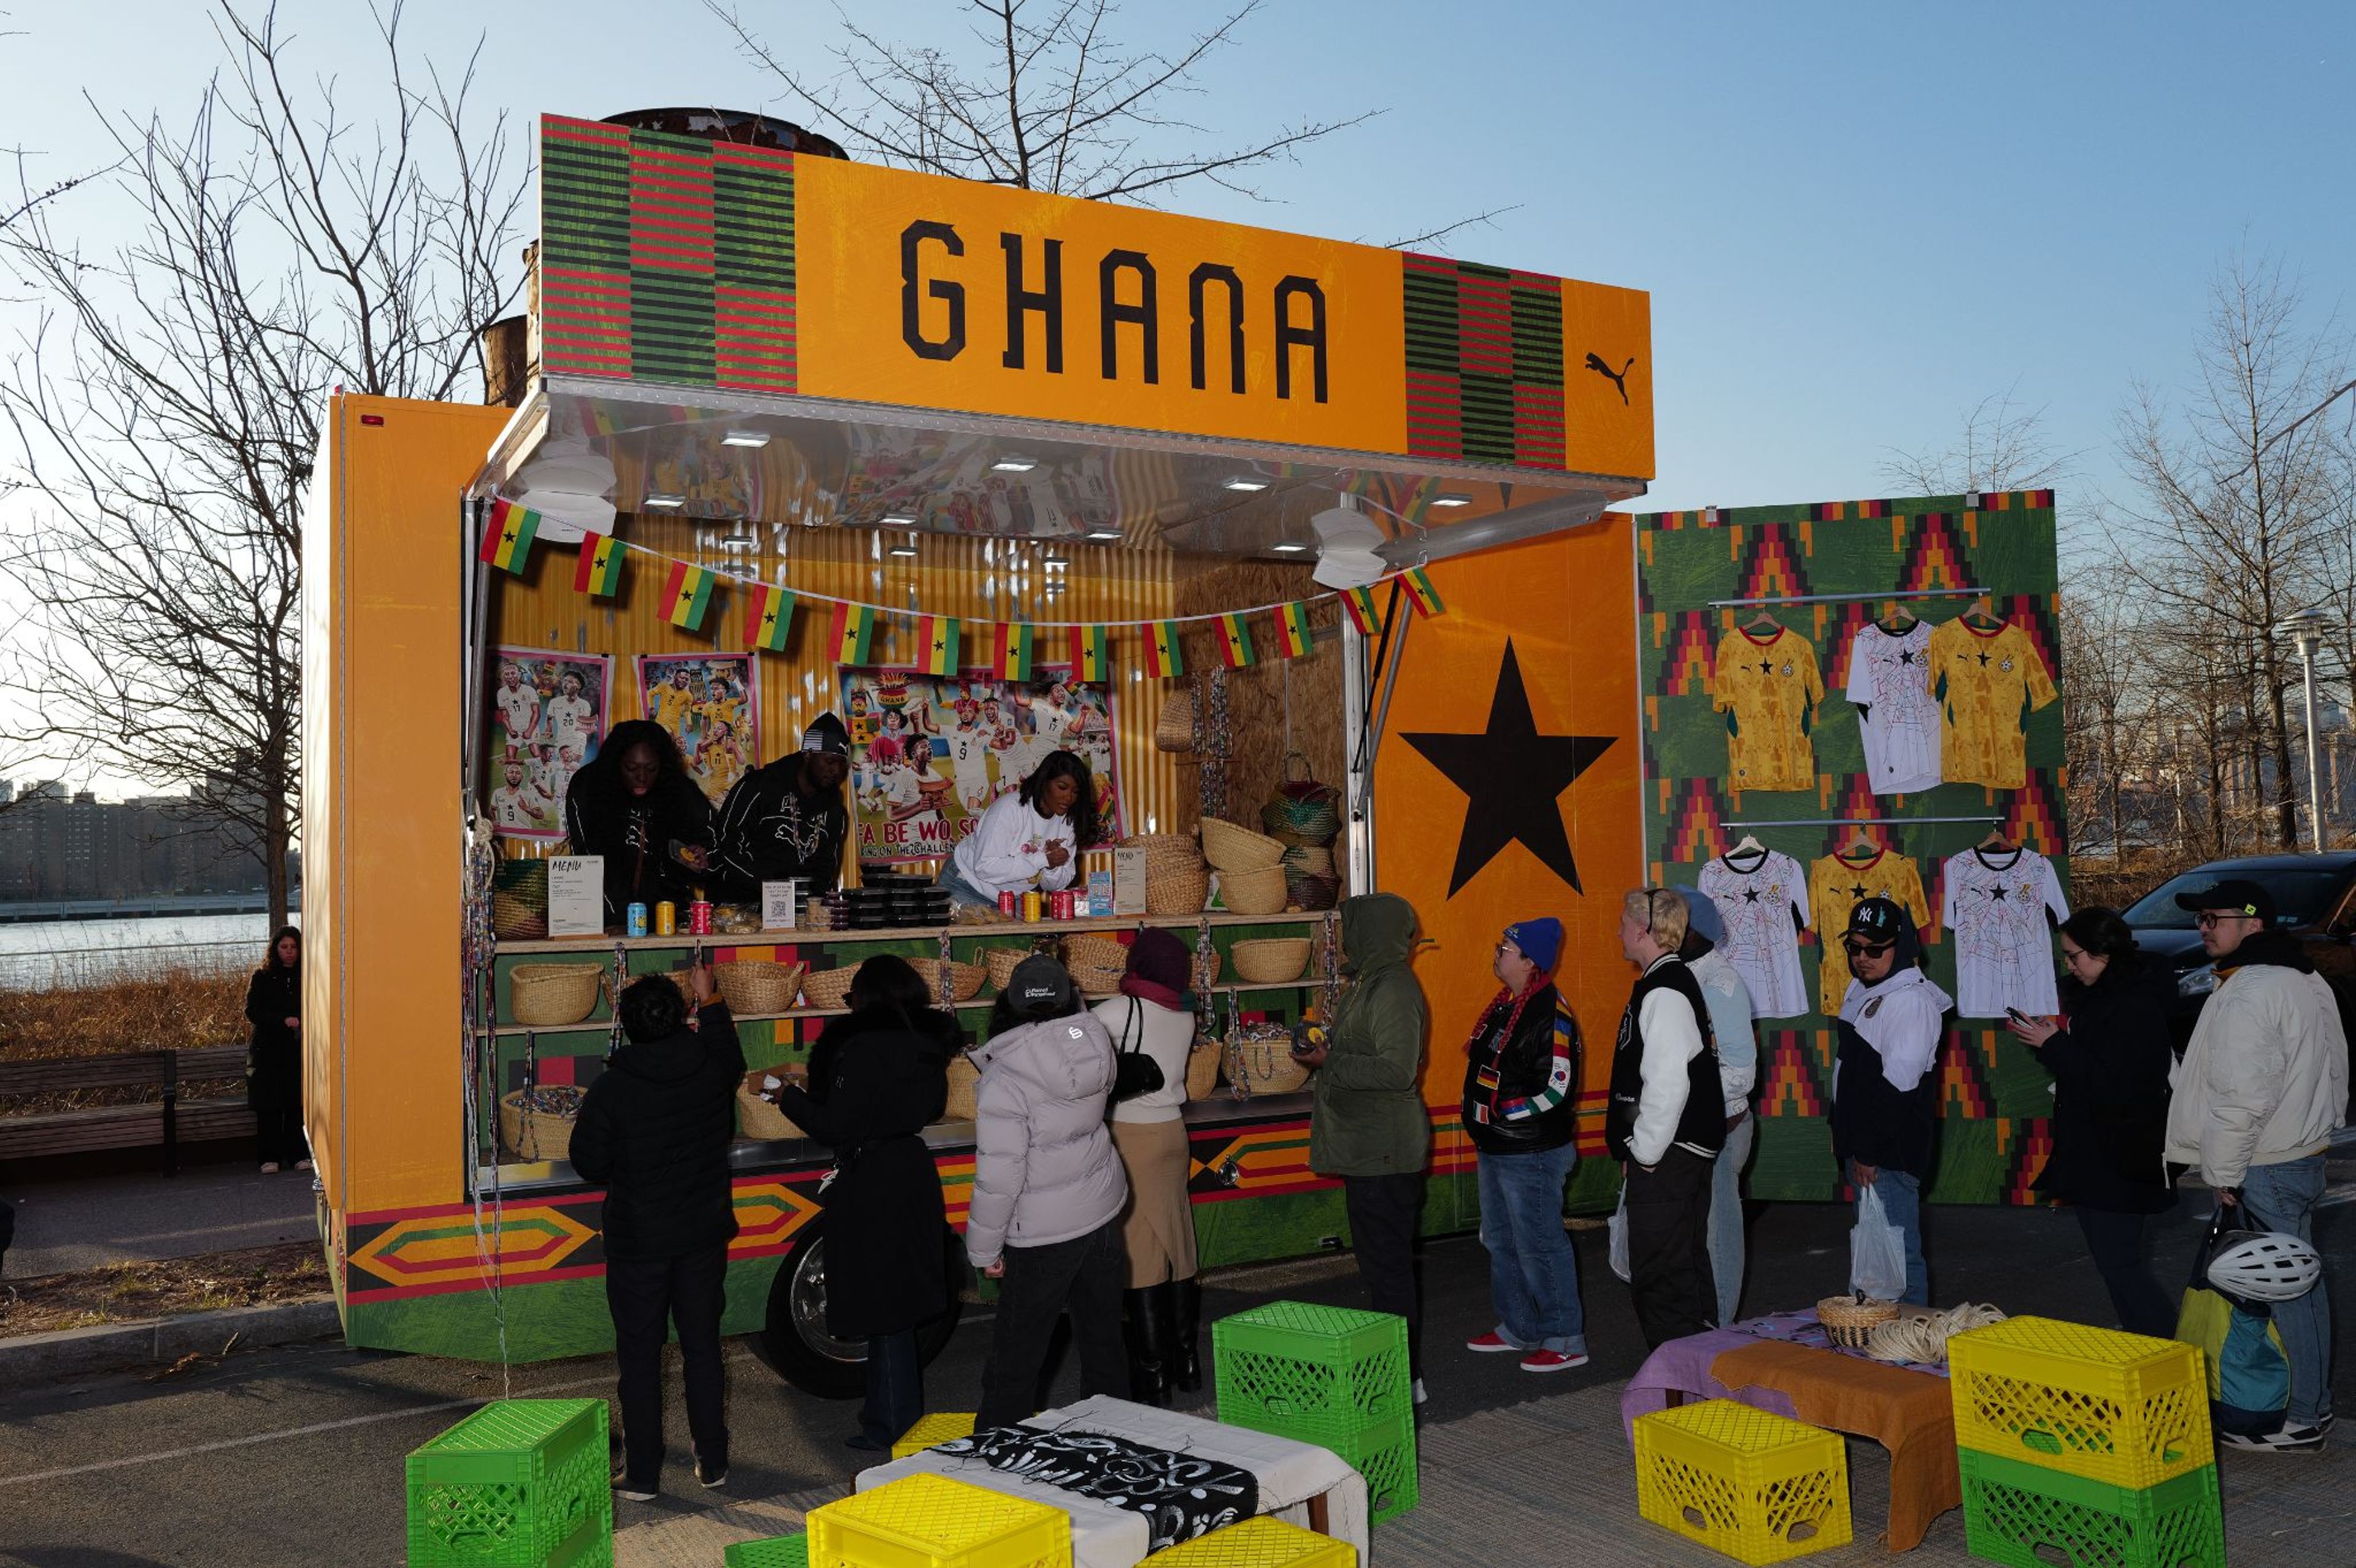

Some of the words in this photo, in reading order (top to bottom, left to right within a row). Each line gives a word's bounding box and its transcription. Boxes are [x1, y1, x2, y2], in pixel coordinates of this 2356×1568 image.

[901, 219, 1328, 404] GHANA
[1049, 723, 1058, 731] 17
[959, 747, 967, 760] 9
[508, 811, 515, 821] 9
[883, 821, 908, 843] BE
[880, 846, 892, 856] ON
[896, 844, 910, 855] THE
[914, 842, 958, 854] CHALLEN
[552, 860, 582, 872] MENU
[1858, 907, 1873, 922] NY
